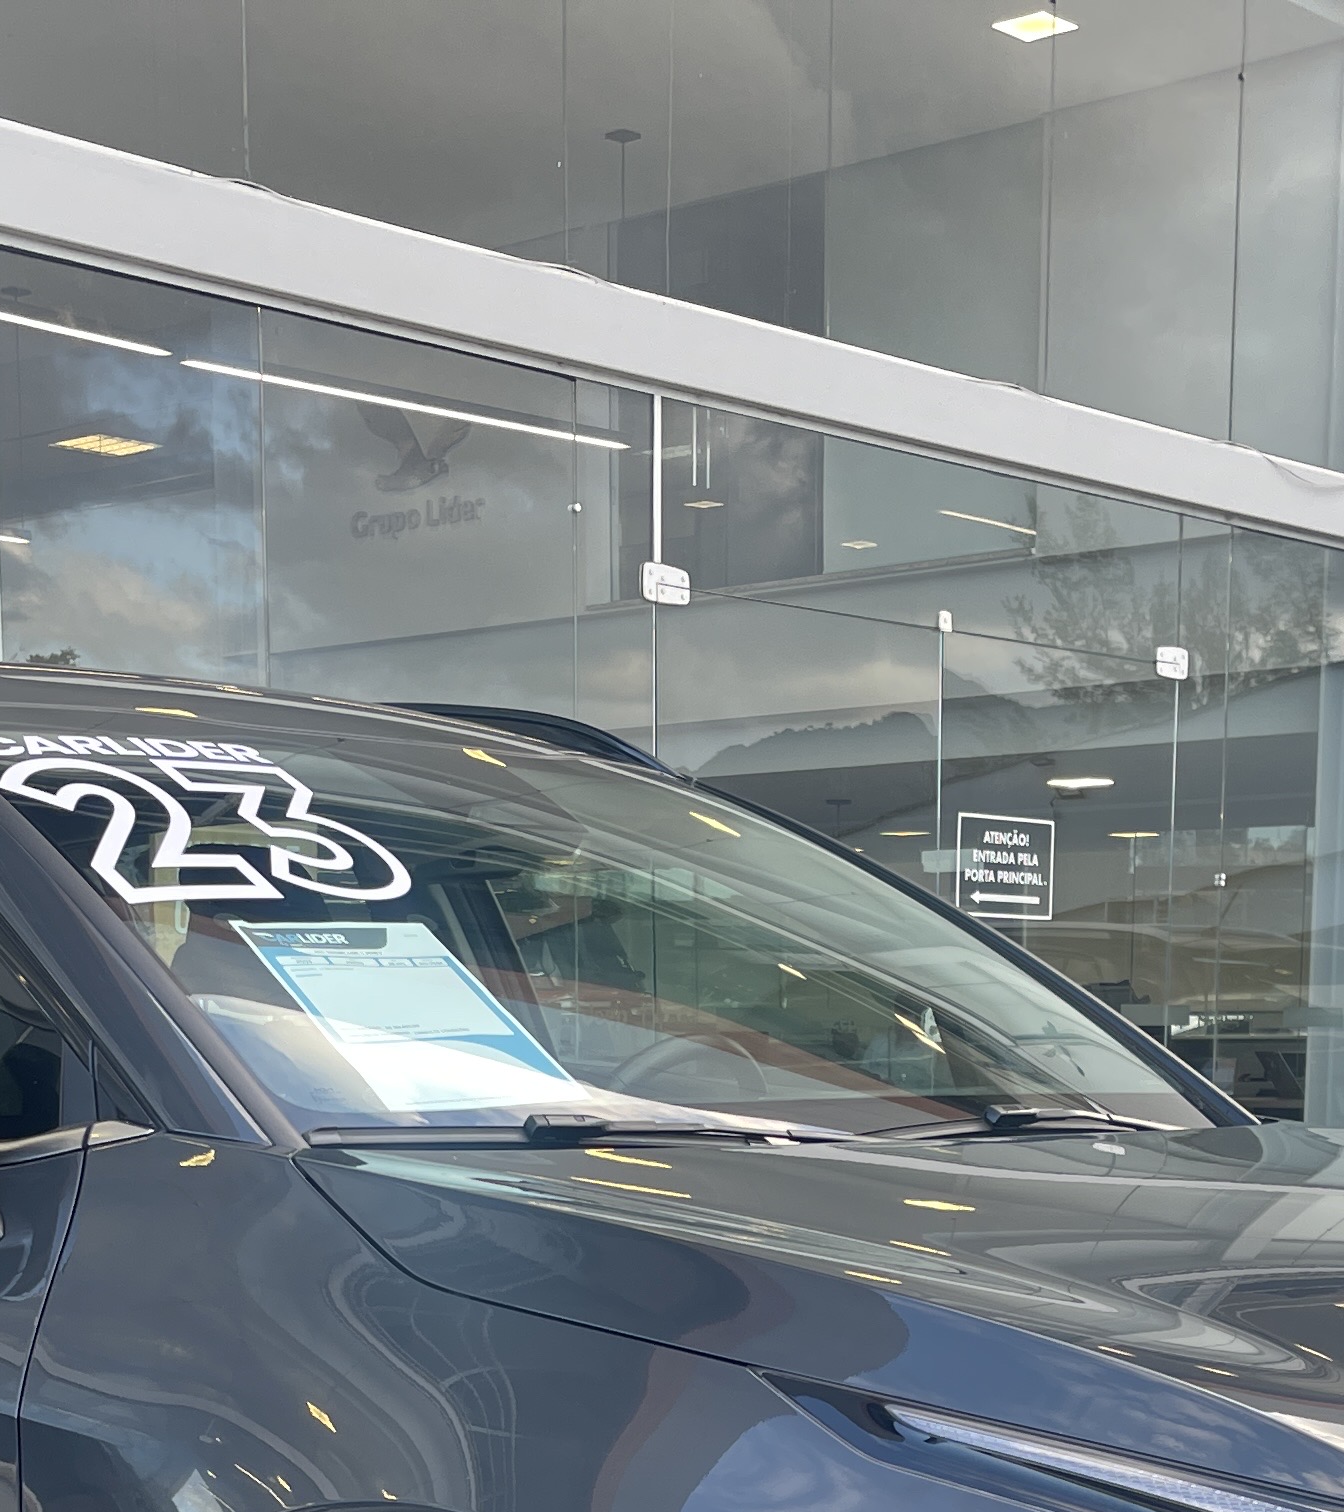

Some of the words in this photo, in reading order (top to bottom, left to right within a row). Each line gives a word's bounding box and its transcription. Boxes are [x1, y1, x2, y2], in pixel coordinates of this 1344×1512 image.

[350, 509, 421, 541] Grupo
[983, 830, 1030, 848] ATENÇÃO!
[972, 850, 1015, 866] ENTRADA
[1017, 852, 1039, 867] PELA
[965, 868, 995, 883] PORTA
[997, 870, 1048, 886] PRINCIPAL.
[252, 931, 350, 945] CARLIDER
